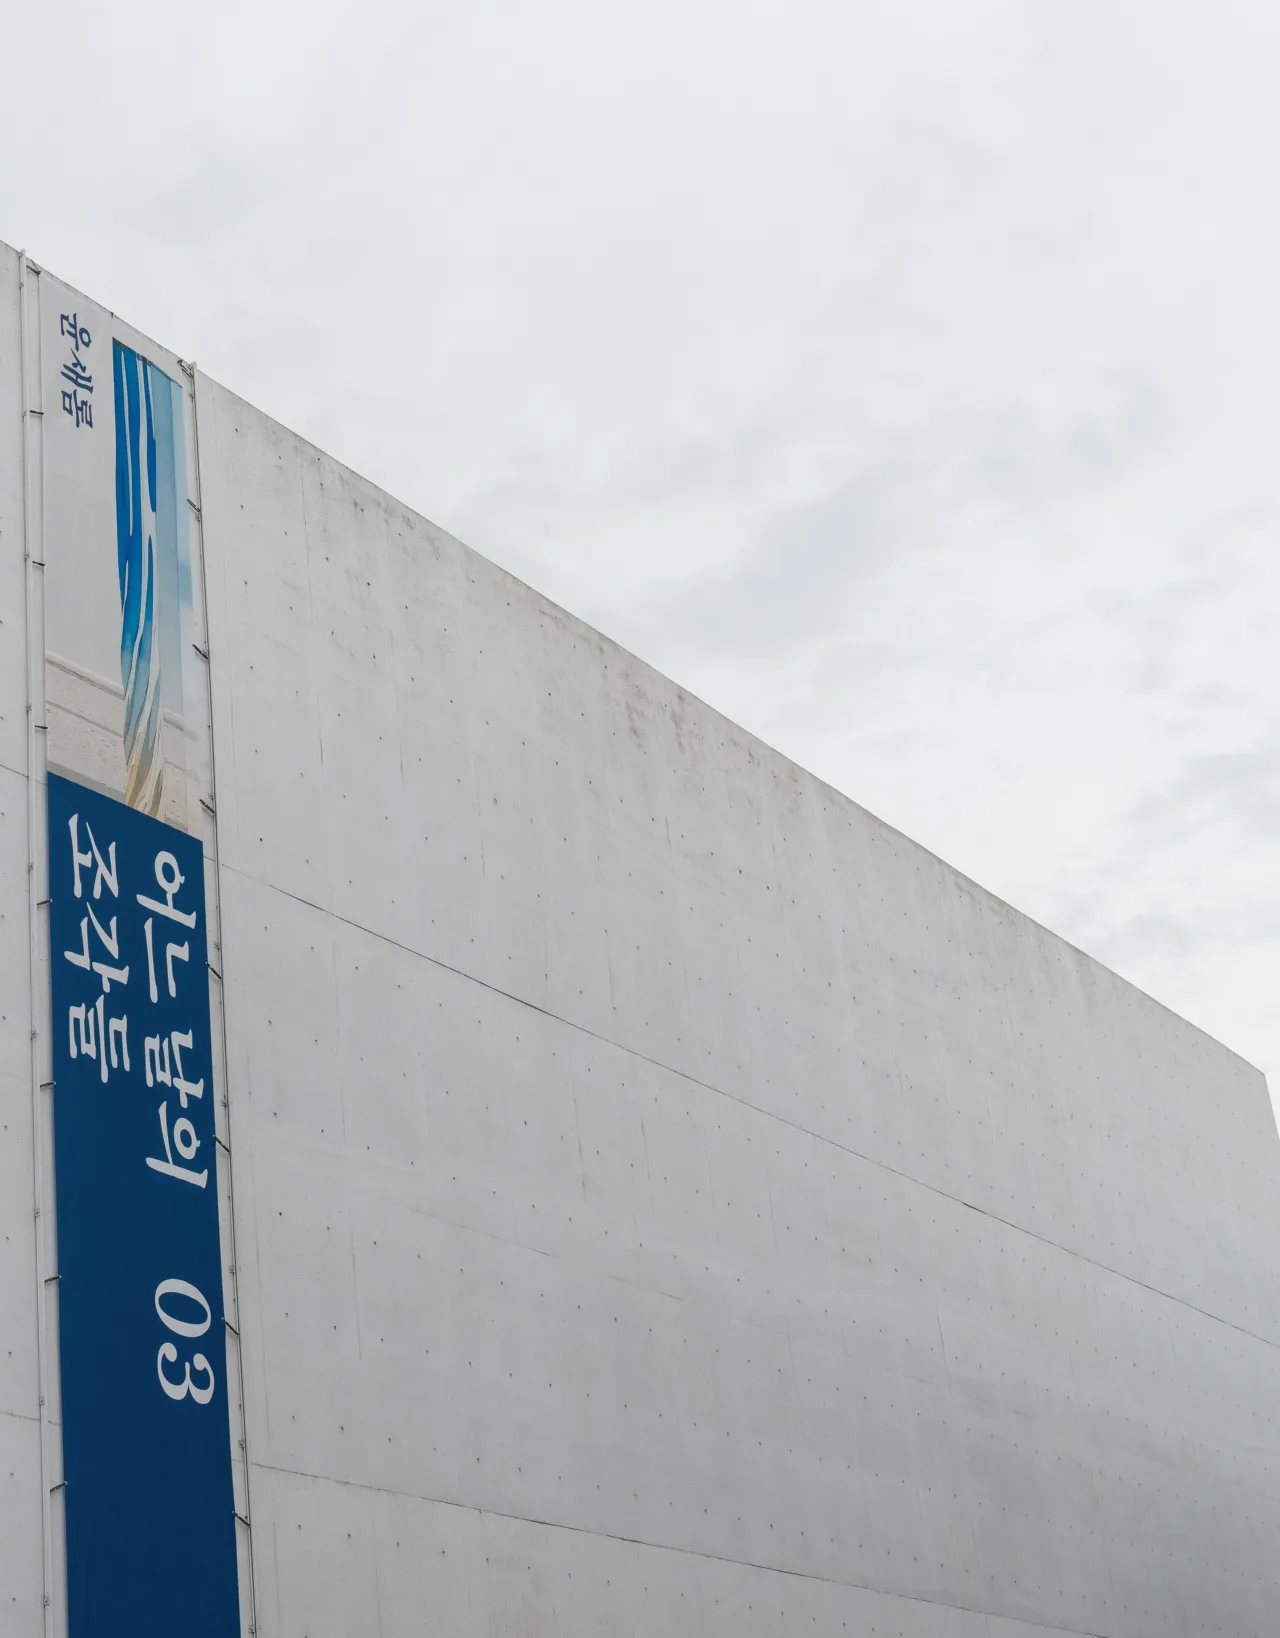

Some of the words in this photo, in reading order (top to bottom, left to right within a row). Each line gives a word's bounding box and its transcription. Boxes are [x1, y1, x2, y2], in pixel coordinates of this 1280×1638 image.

[60, 312, 94, 429] 윤새롬
[63, 813, 131, 1083] 조각들
[136, 850, 197, 1004] 어느
[144, 1028, 208, 1189] 날의
[154, 1278, 216, 1405] 03
